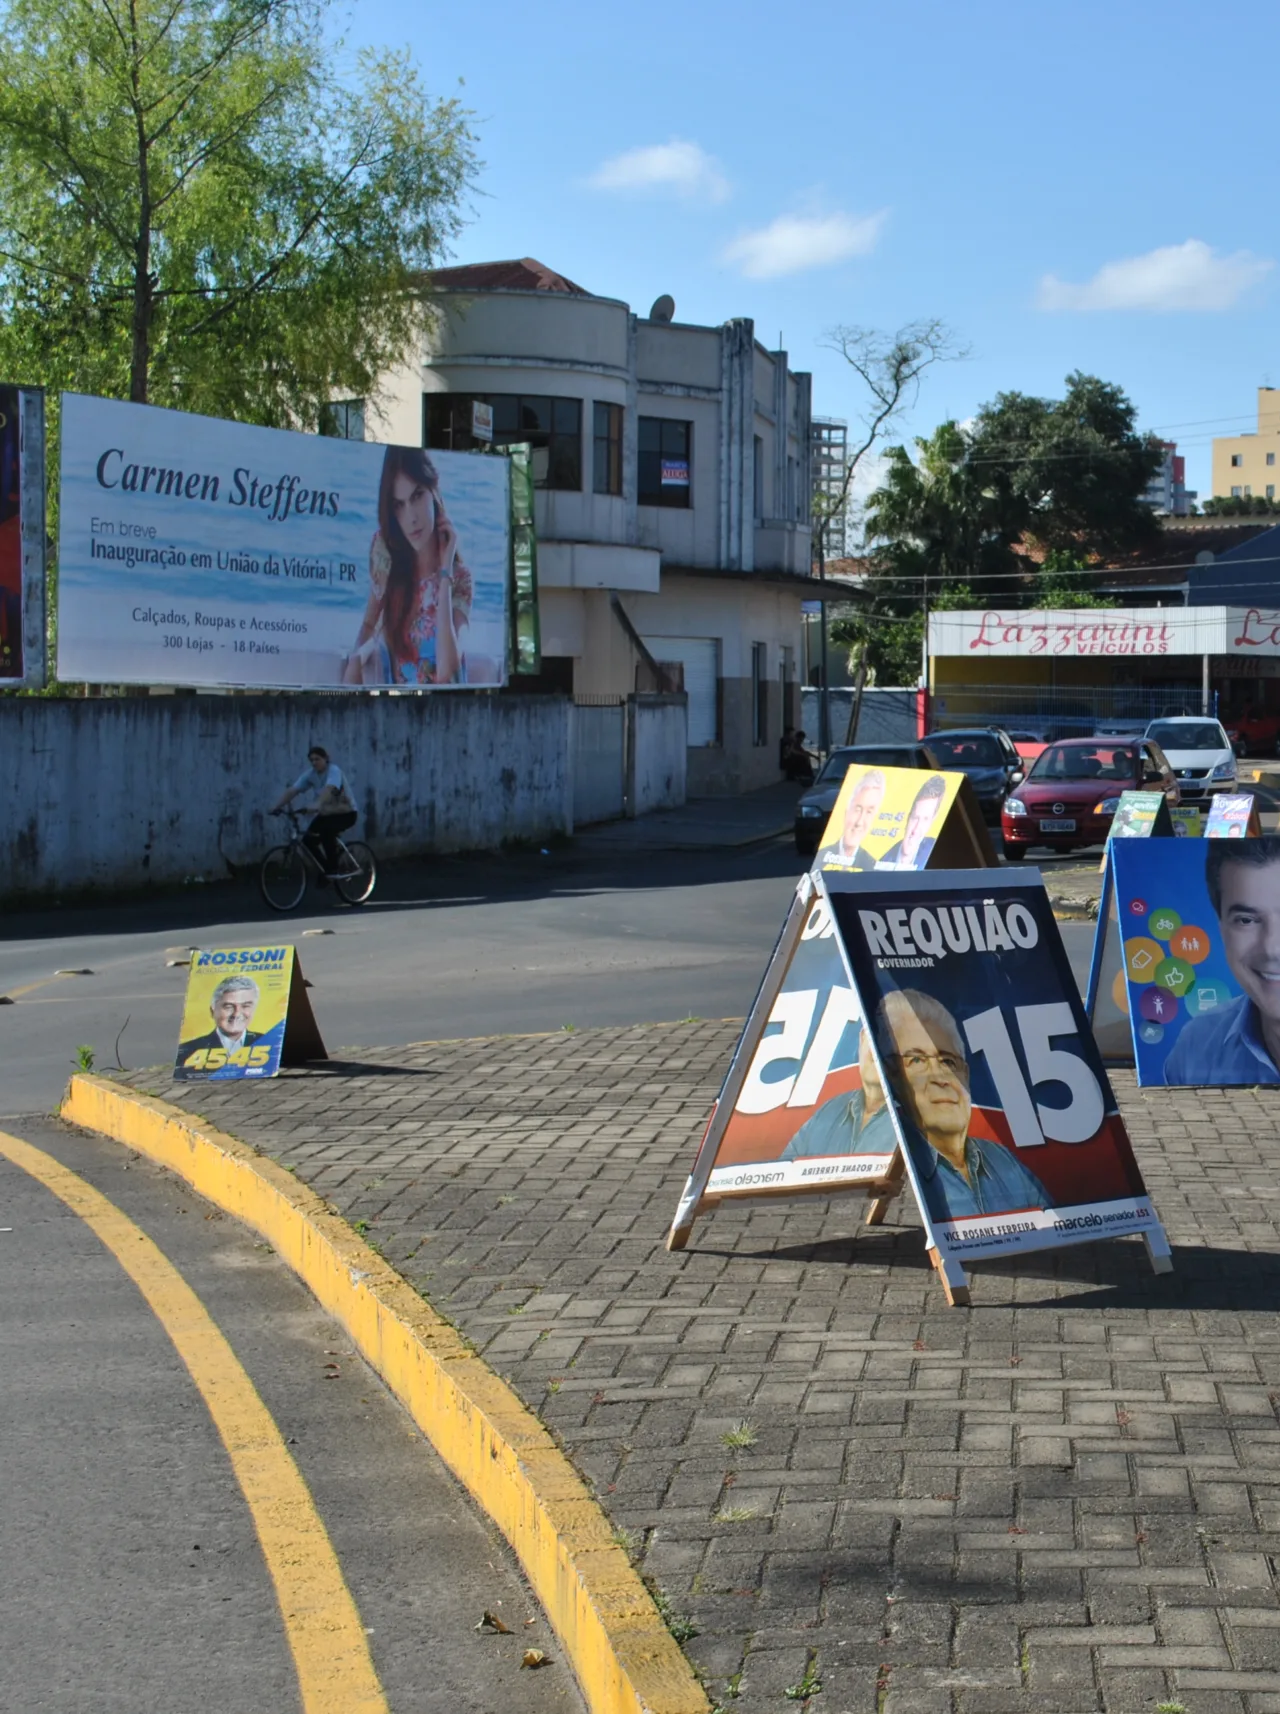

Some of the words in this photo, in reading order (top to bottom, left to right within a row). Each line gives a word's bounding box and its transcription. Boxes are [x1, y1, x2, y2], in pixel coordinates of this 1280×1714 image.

[96, 448, 219, 501] Carmen
[228, 467, 340, 522] Steffens
[91, 517, 114, 535] Em
[119, 520, 157, 539] breve
[90, 538, 186, 569] Inauguração
[191, 552, 212, 569] em
[217, 551, 259, 574] União
[263, 555, 280, 576] da
[282, 556, 326, 580] Vitória
[339, 562, 357, 582] PR
[132, 607, 190, 627] Calçados,
[194, 612, 236, 631] Roupas
[239, 619, 246, 629] e
[250, 617, 308, 634] Acessórios
[970, 612, 1174, 654] Lazzarini
[163, 635, 183, 649] 300
[186, 637, 214, 653] Lojas
[234, 641, 246, 653] 18
[249, 640, 280, 655] Países
[858, 899, 1039, 960] REQUIÃO
[197, 948, 286, 966] ROSSONI
[877, 957, 935, 969] GOVERNADOR
[183, 1045, 271, 1070] 4545
[962, 1001, 1105, 1148] 15
[943, 1230, 961, 1242] VICE
[963, 1225, 996, 1240] ROSANE
[997, 1221, 1038, 1237] FERREIRA
[1053, 1213, 1103, 1232] marcelo
[1102, 1212, 1135, 1223] senador
[1135, 1209, 1150, 1219] 151
